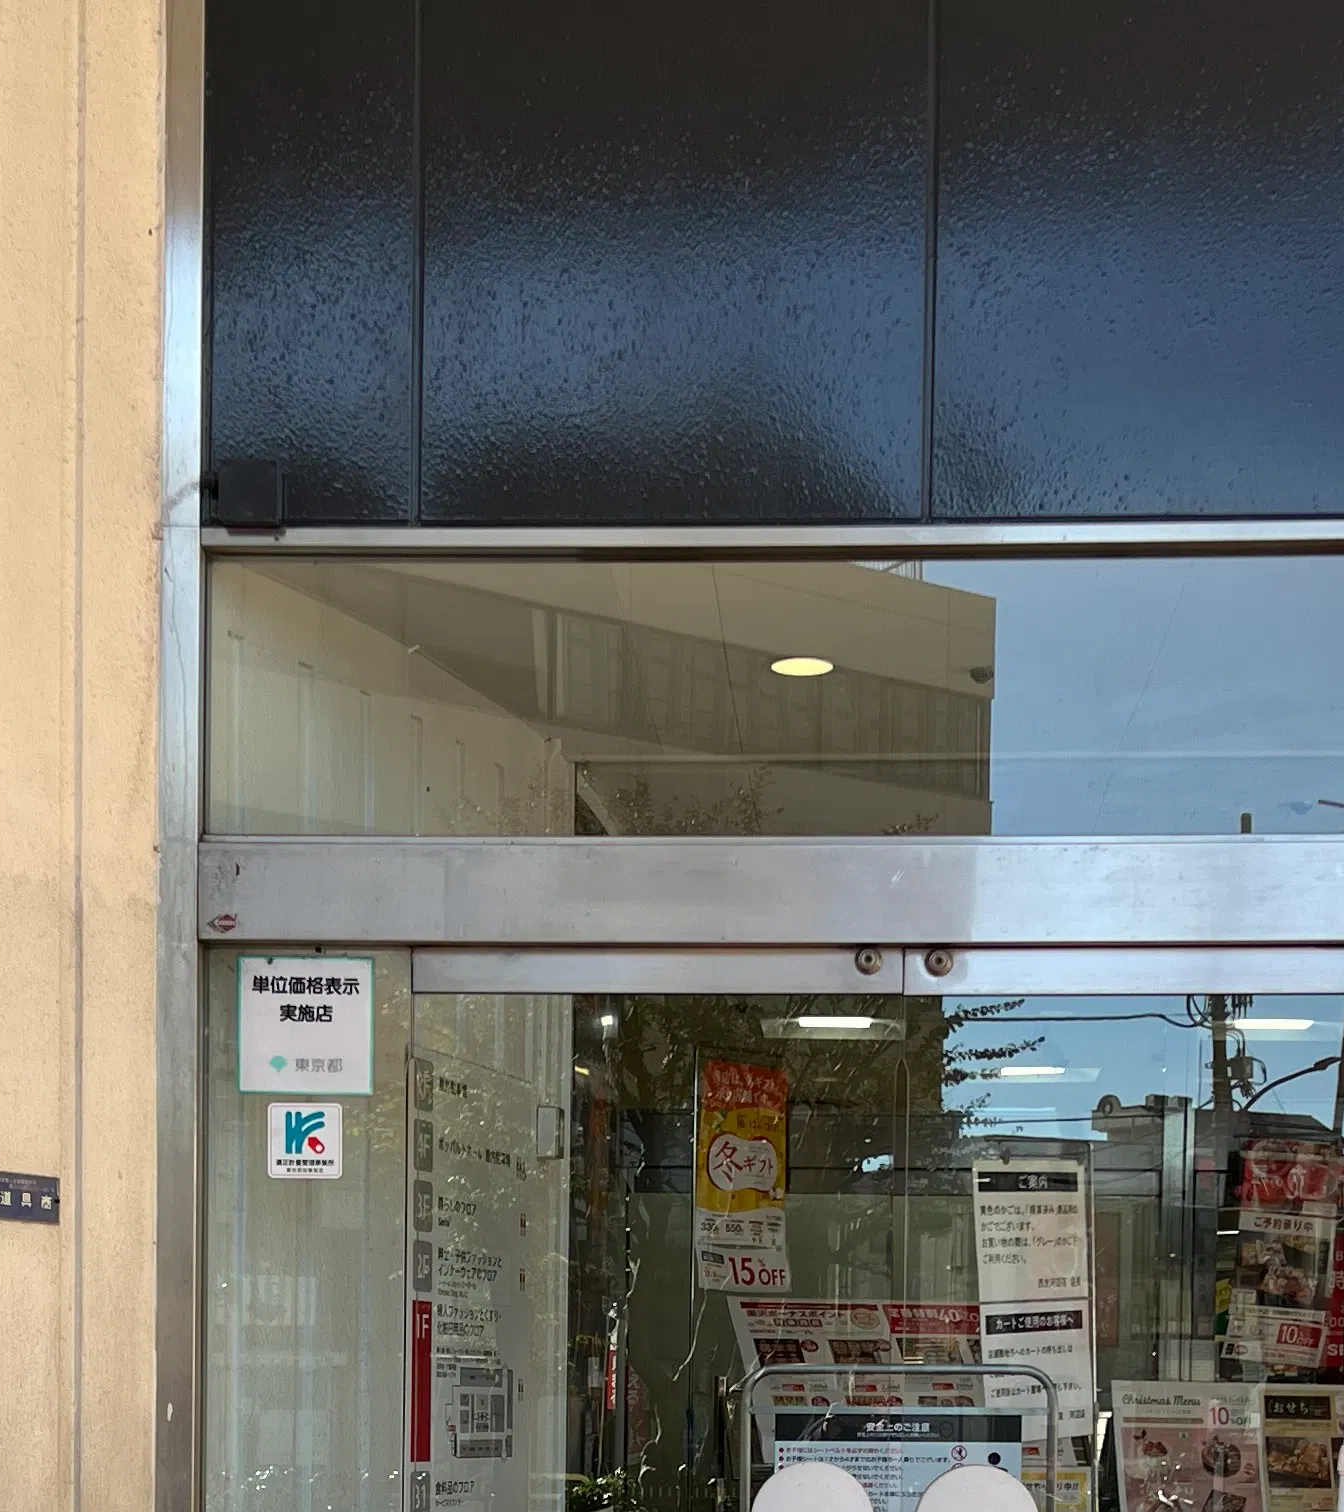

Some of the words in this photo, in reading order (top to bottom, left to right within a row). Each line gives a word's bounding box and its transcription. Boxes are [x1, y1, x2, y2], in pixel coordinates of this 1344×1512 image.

[252, 976, 360, 995] 単位価格表示
[280, 1004, 333, 1023] 実施店
[295, 1058, 344, 1073] 東京都
